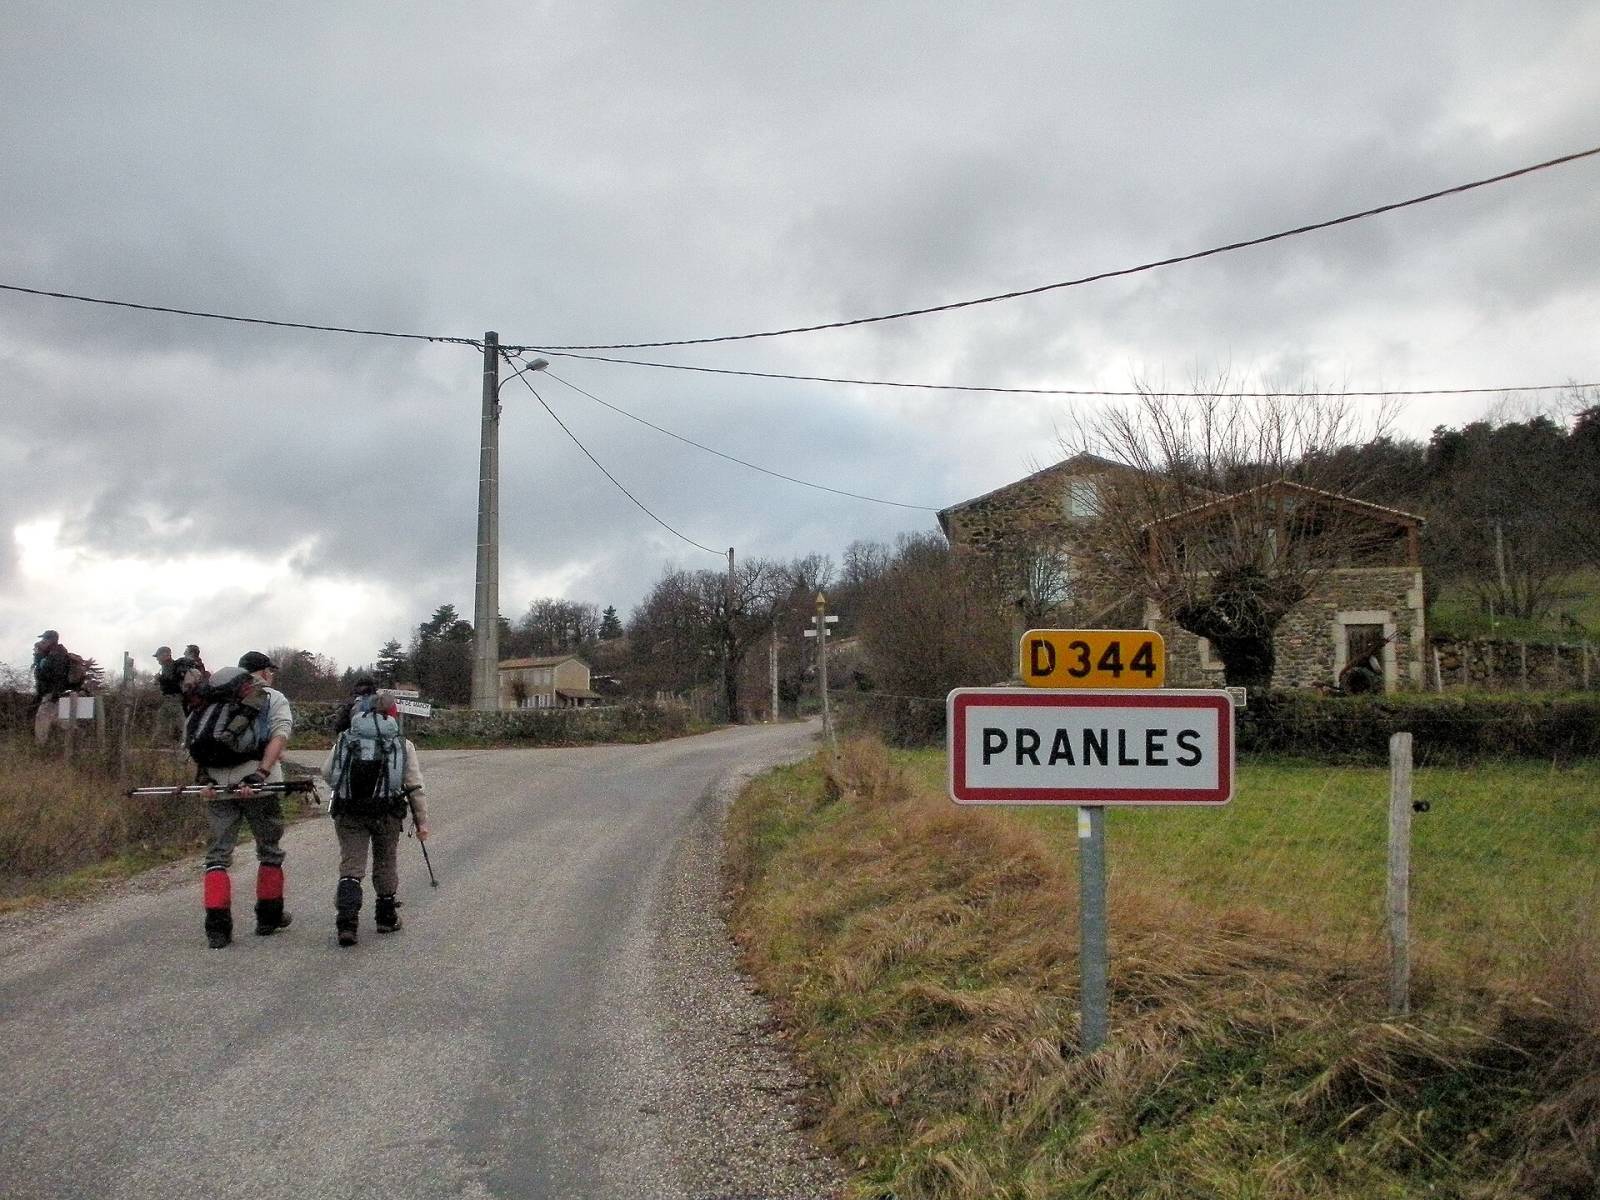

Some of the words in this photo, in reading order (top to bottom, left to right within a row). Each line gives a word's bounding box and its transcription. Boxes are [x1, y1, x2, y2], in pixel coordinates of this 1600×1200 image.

[1030, 639, 1057, 677] D
[1067, 640, 1158, 679] 344
[982, 727, 1203, 768] PRANLES
